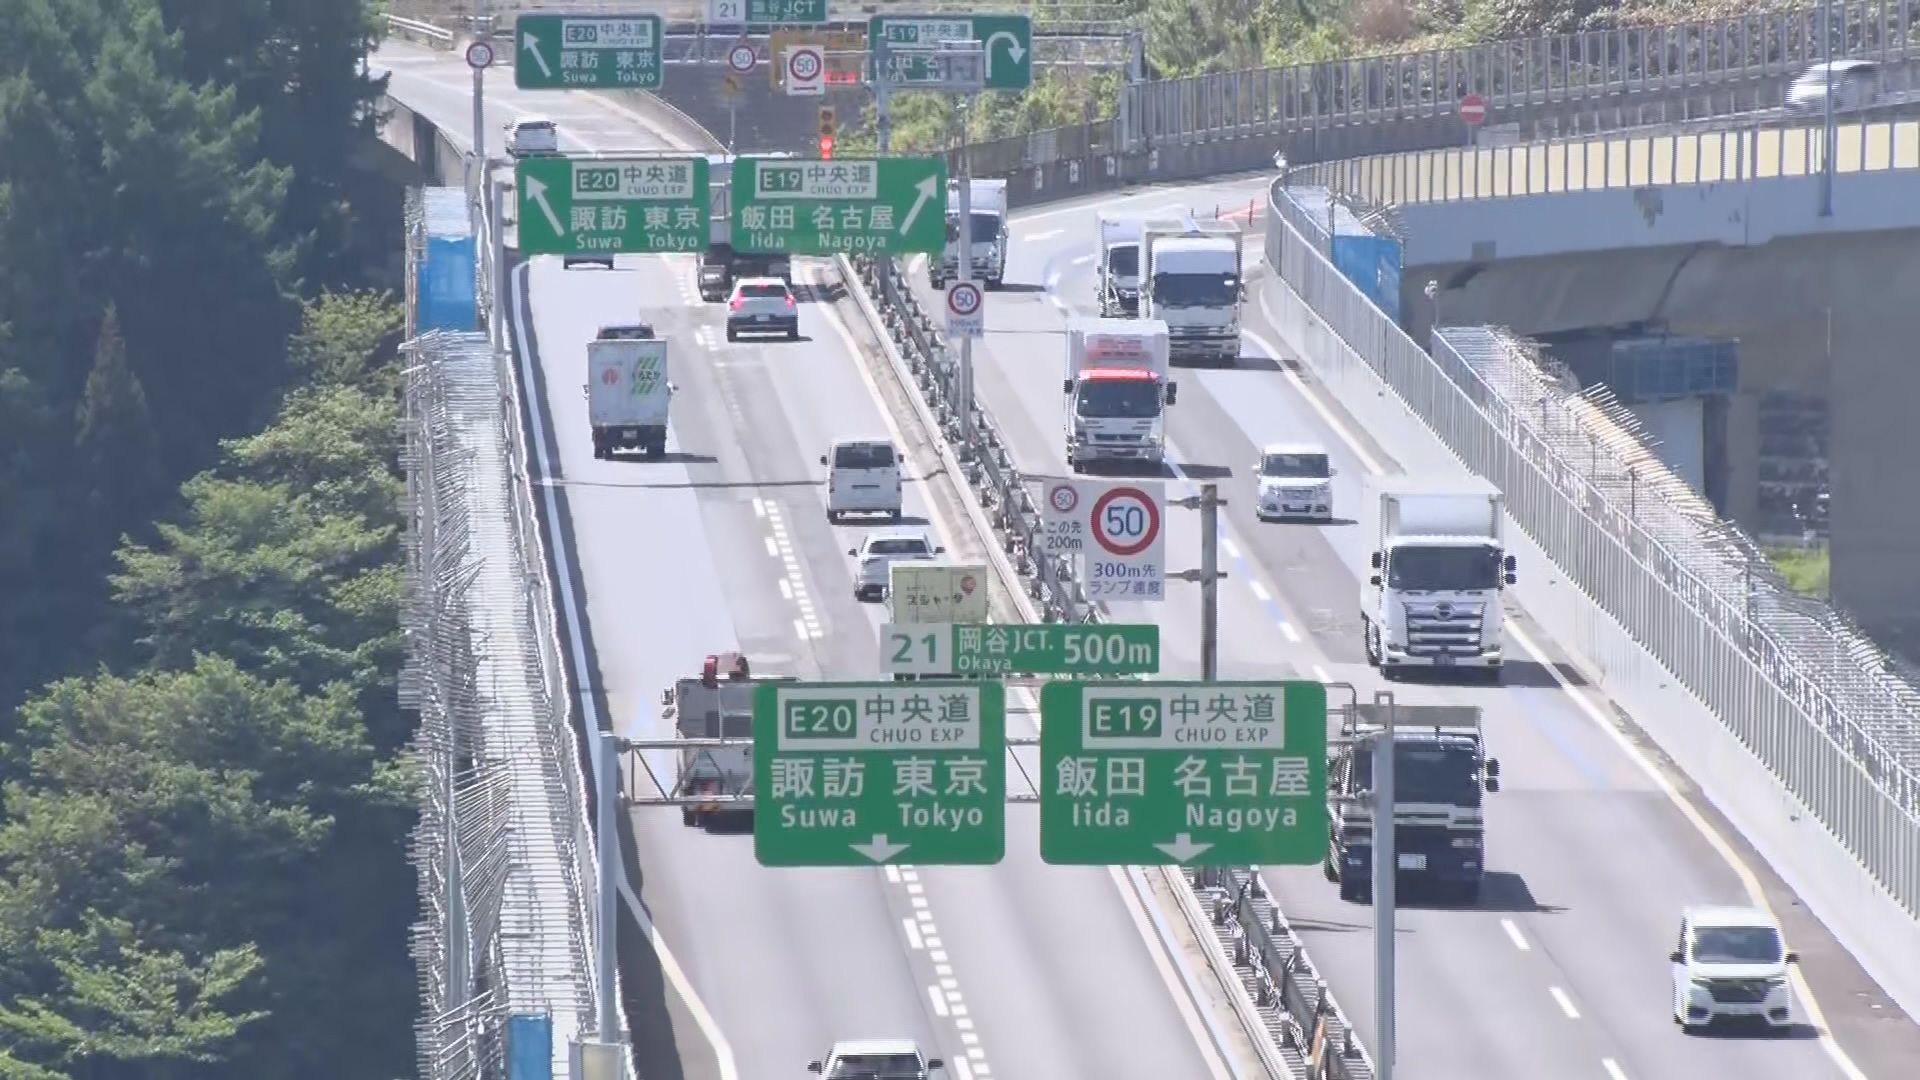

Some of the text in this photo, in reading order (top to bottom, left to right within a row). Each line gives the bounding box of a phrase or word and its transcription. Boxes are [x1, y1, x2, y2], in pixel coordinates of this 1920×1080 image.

[720, 3, 737, 17] 21
[566, 27, 596, 40] E20
[887, 26, 917, 40] E19
[560, 50, 655, 68] 諏訪 東京
[796, 58, 814, 72] 50
[562, 71, 655, 83] Suwa Tokyo
[578, 172, 617, 189] E20
[624, 166, 688, 184] 中央道
[763, 171, 801, 189] E19
[807, 166, 872, 184] 中央道
[570, 206, 701, 231] 諏訪 東京
[741, 206, 895, 230] 飯田 名古屋
[576, 233, 699, 251] Suwa Tokyo
[750, 232, 887, 251] Iida Nagoya
[956, 291, 974, 307] 50
[1057, 492, 1072, 506] 50
[1046, 521, 1083, 535] この先
[1107, 506, 1144, 537] 50
[1047, 536, 1083, 550] 200m
[1094, 562, 1157, 578] 300m先
[1089, 580, 1161, 595] ランプ速度
[891, 633, 937, 664] 21
[1064, 634, 1152, 665] 500m
[958, 656, 1013, 673] Okaya
[864, 693, 971, 725] 中央道
[1096, 704, 1157, 731] E19
[1169, 693, 1276, 725] 中央道
[790, 705, 853, 733] E20
[869, 728, 965, 744] CHUO EXP
[1174, 728, 1269, 743] CHUO EXP
[770, 756, 988, 800] 諏訪 東京
[1056, 755, 1312, 798] 飯田 名古屋
[781, 802, 984, 833] Suwa Tokyo
[1072, 802, 1298, 833] Iida Nagoya
